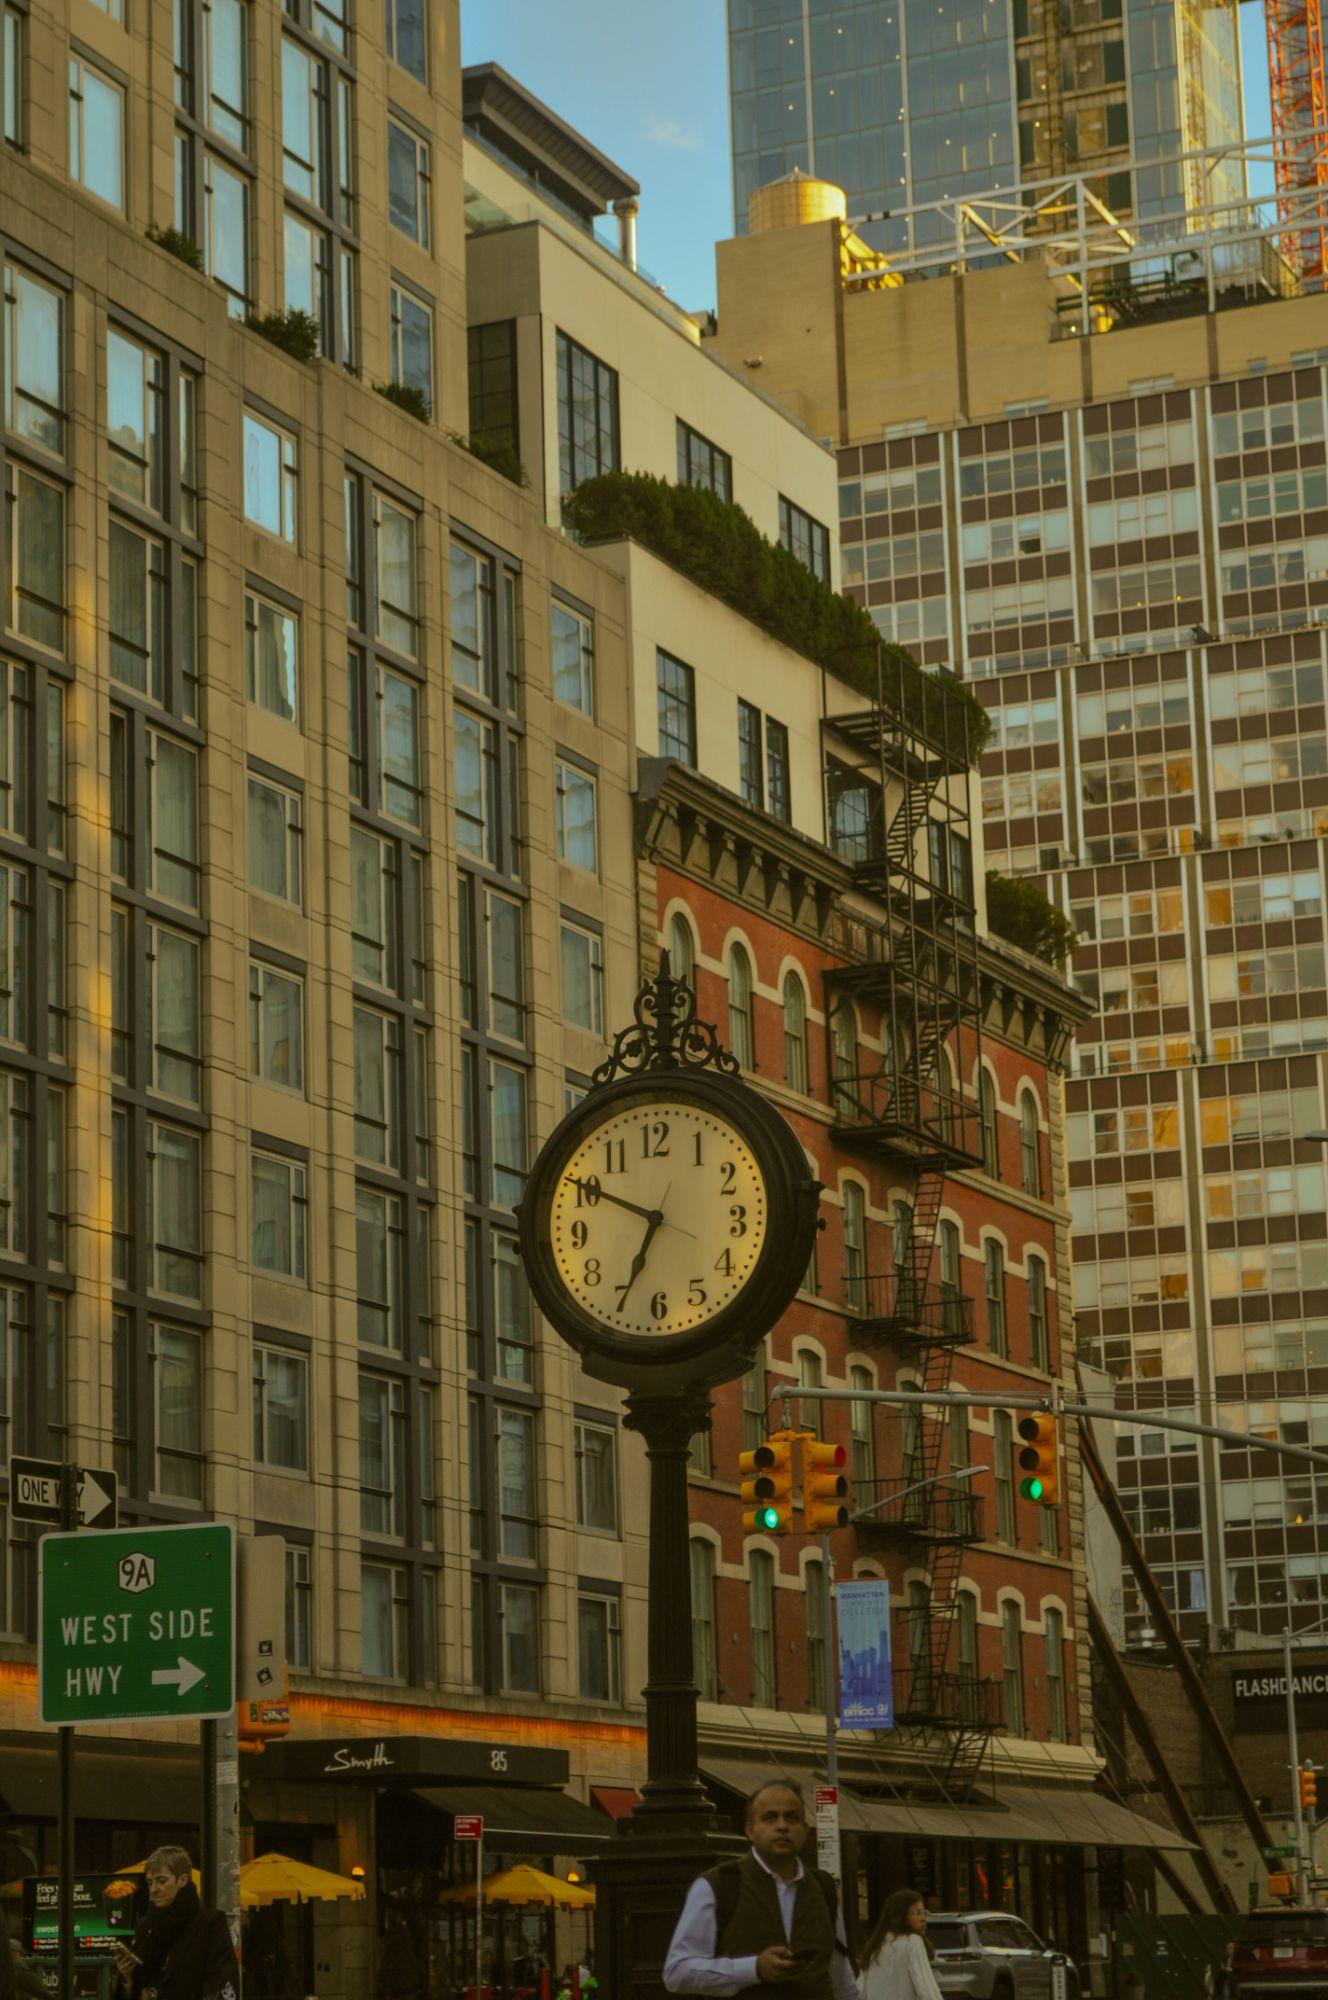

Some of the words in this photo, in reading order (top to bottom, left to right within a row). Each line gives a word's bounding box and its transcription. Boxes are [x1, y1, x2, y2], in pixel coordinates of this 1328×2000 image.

[640, 1121, 670, 1159] 12
[692, 1131, 705, 1168] 1
[603, 1138, 628, 1174] 11
[574, 1175, 601, 1208] 10
[720, 1162, 737, 1196] 2
[571, 1220, 588, 1249] 9
[730, 1205, 747, 1237] 3
[584, 1258, 600, 1287] 8
[714, 1248, 736, 1277] 4
[614, 1285, 630, 1313] 7
[650, 1292, 667, 1320] 6
[688, 1279, 707, 1307] 5
[21, 1478, 49, 1503] ONE
[54, 1483, 84, 1508] WY
[121, 1559, 151, 1587] 9A
[61, 1613, 132, 1646] WEST
[149, 1608, 214, 1641] SIDE
[66, 1665, 122, 1697] HWY
[324, 1742, 395, 1771] Smyth
[490, 1750, 508, 1771] 85
